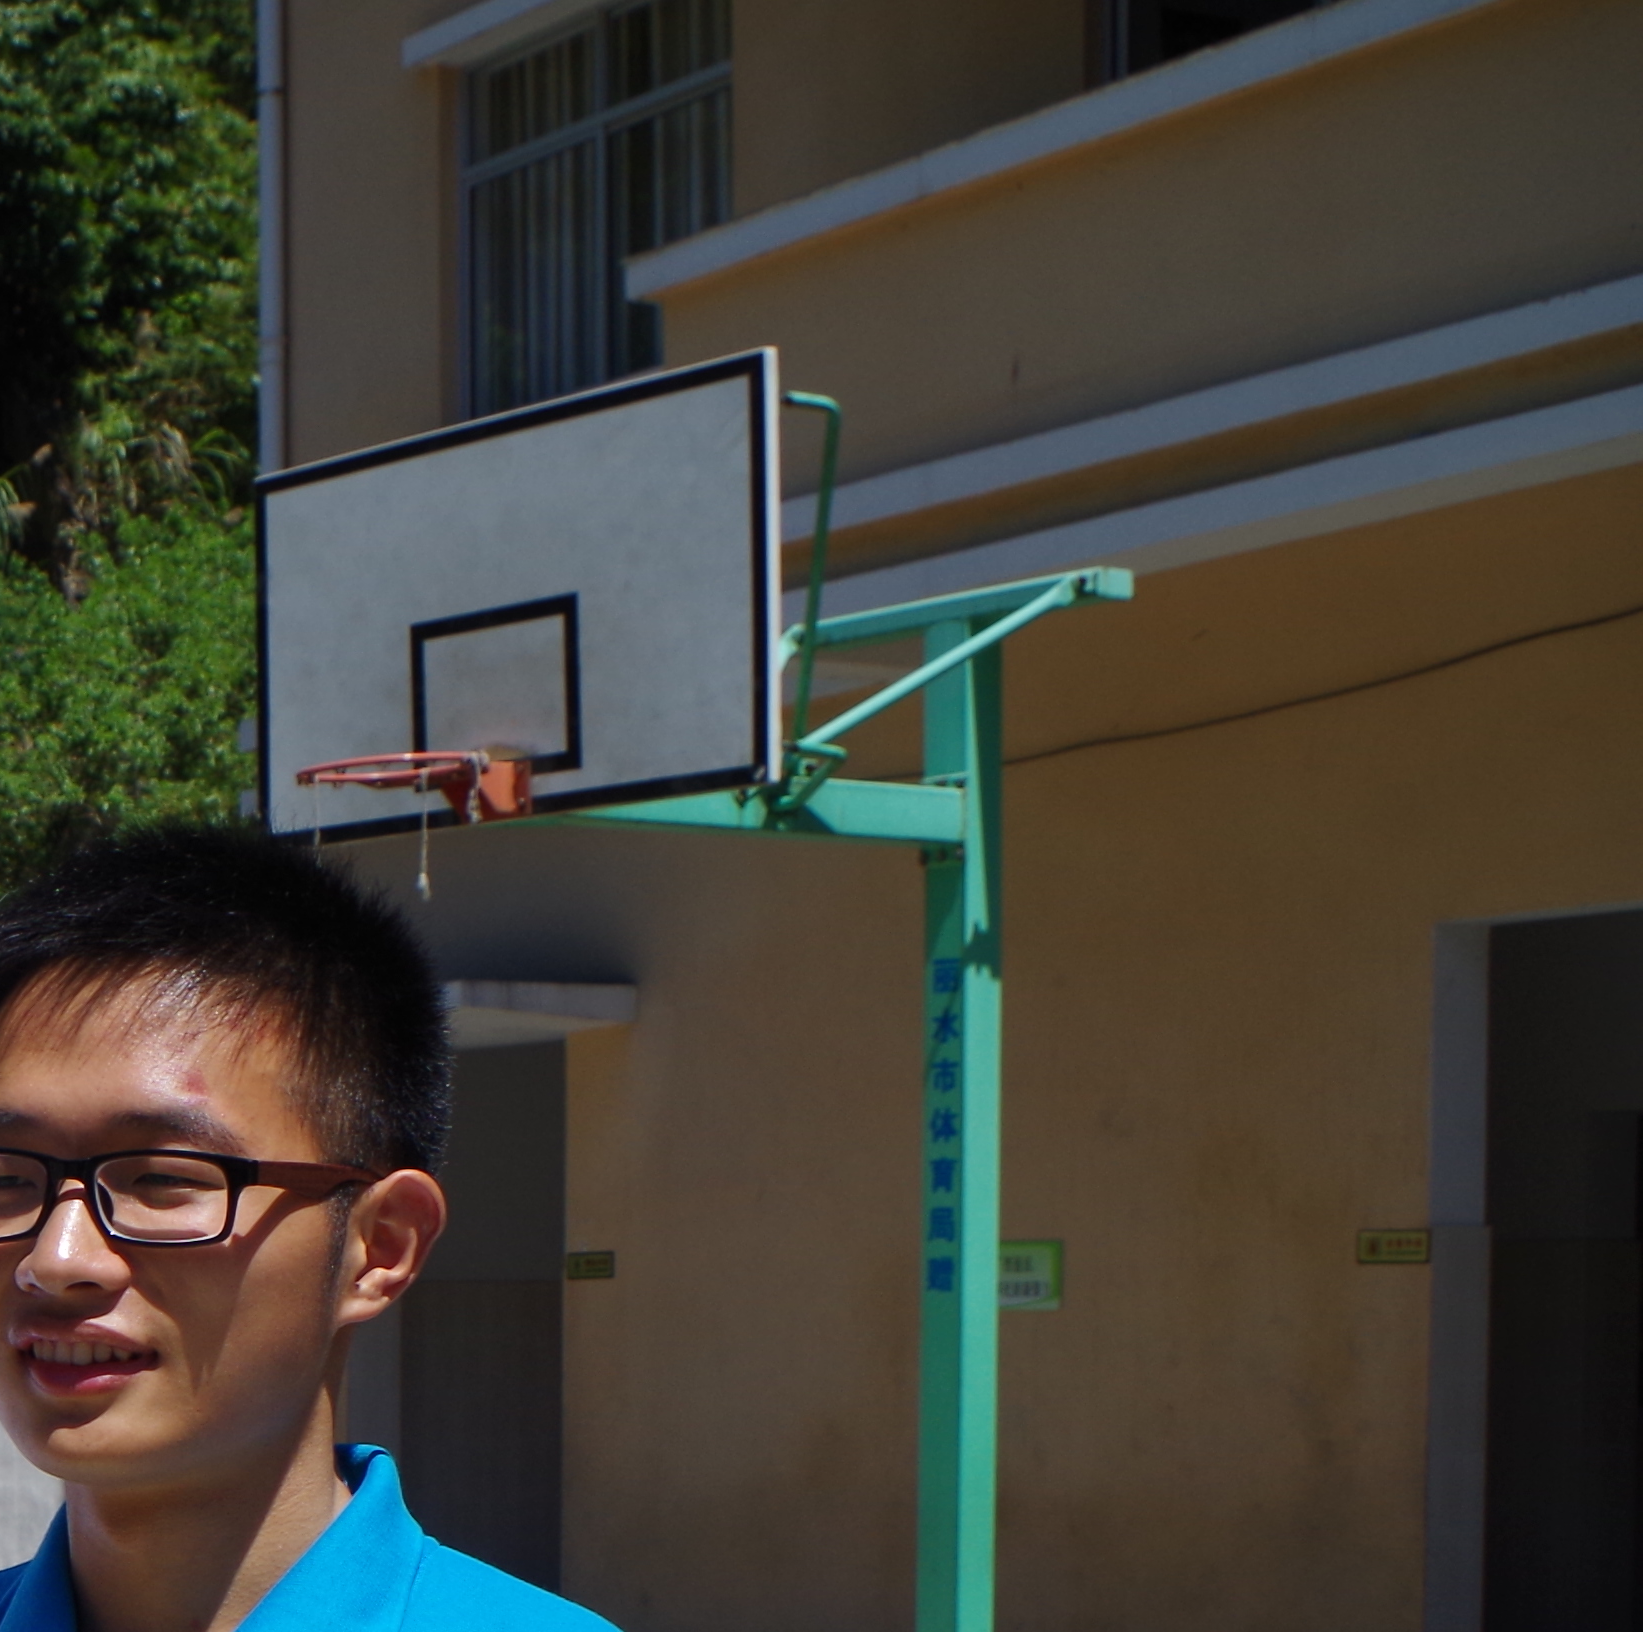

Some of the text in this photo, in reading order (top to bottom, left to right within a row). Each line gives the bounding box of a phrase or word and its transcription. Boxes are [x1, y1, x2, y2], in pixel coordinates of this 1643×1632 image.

[927, 957, 961, 1293] 丽水市体育局赠
